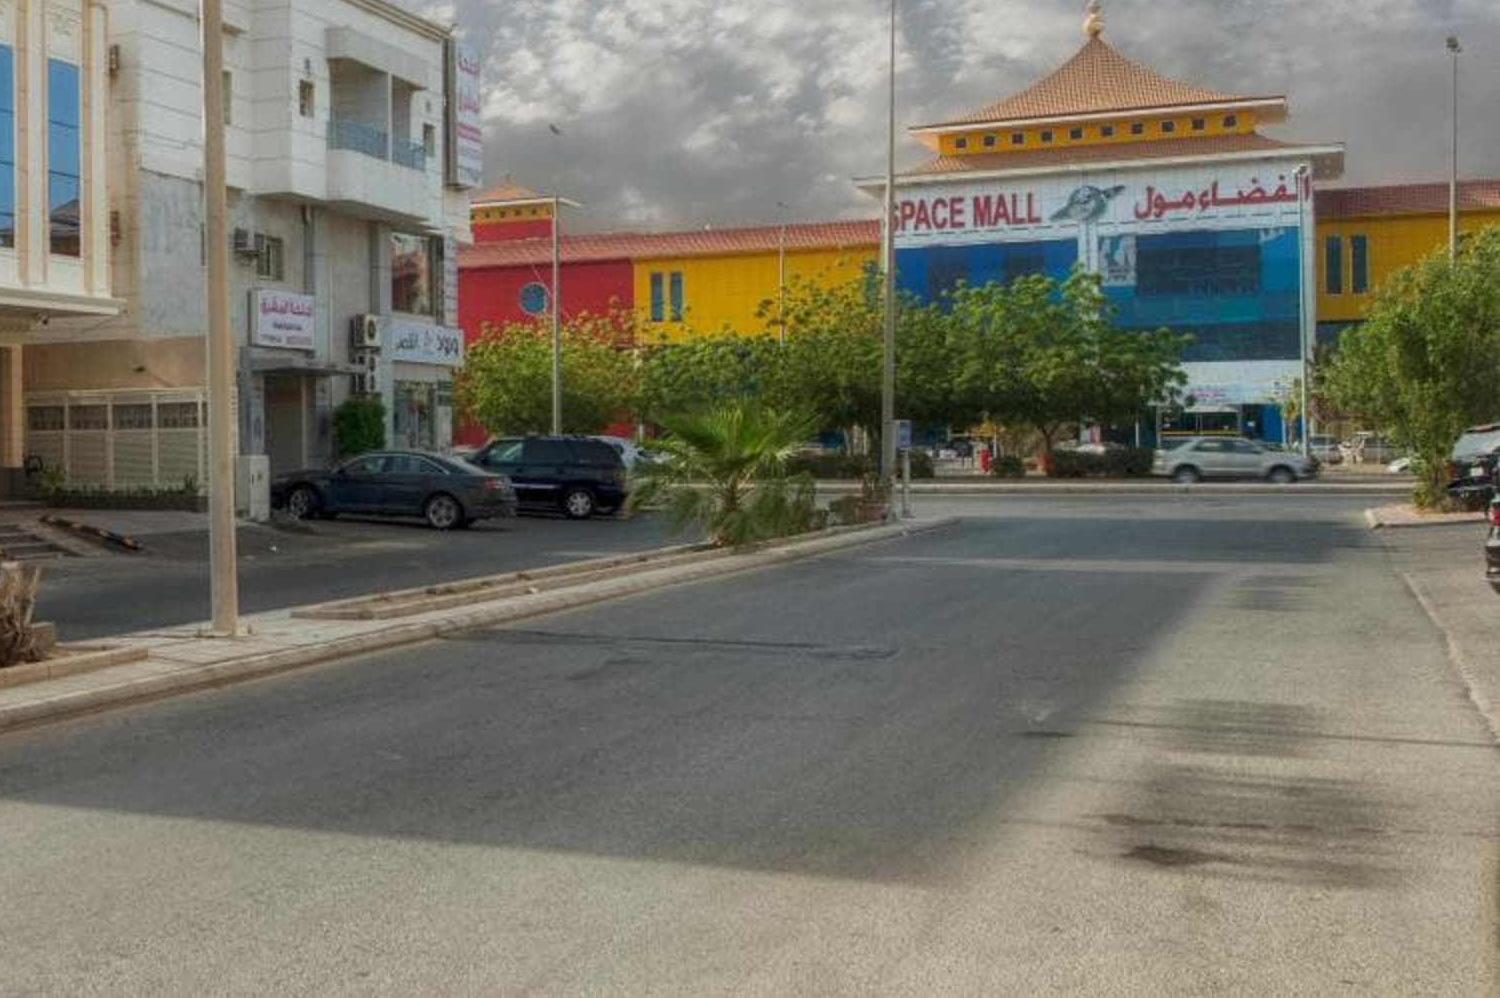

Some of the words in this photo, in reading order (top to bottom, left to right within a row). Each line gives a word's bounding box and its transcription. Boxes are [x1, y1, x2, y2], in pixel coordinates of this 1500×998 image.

[890, 197, 965, 231] SPACE
[972, 192, 1043, 227] MALL
[1134, 185, 1196, 219] مول
